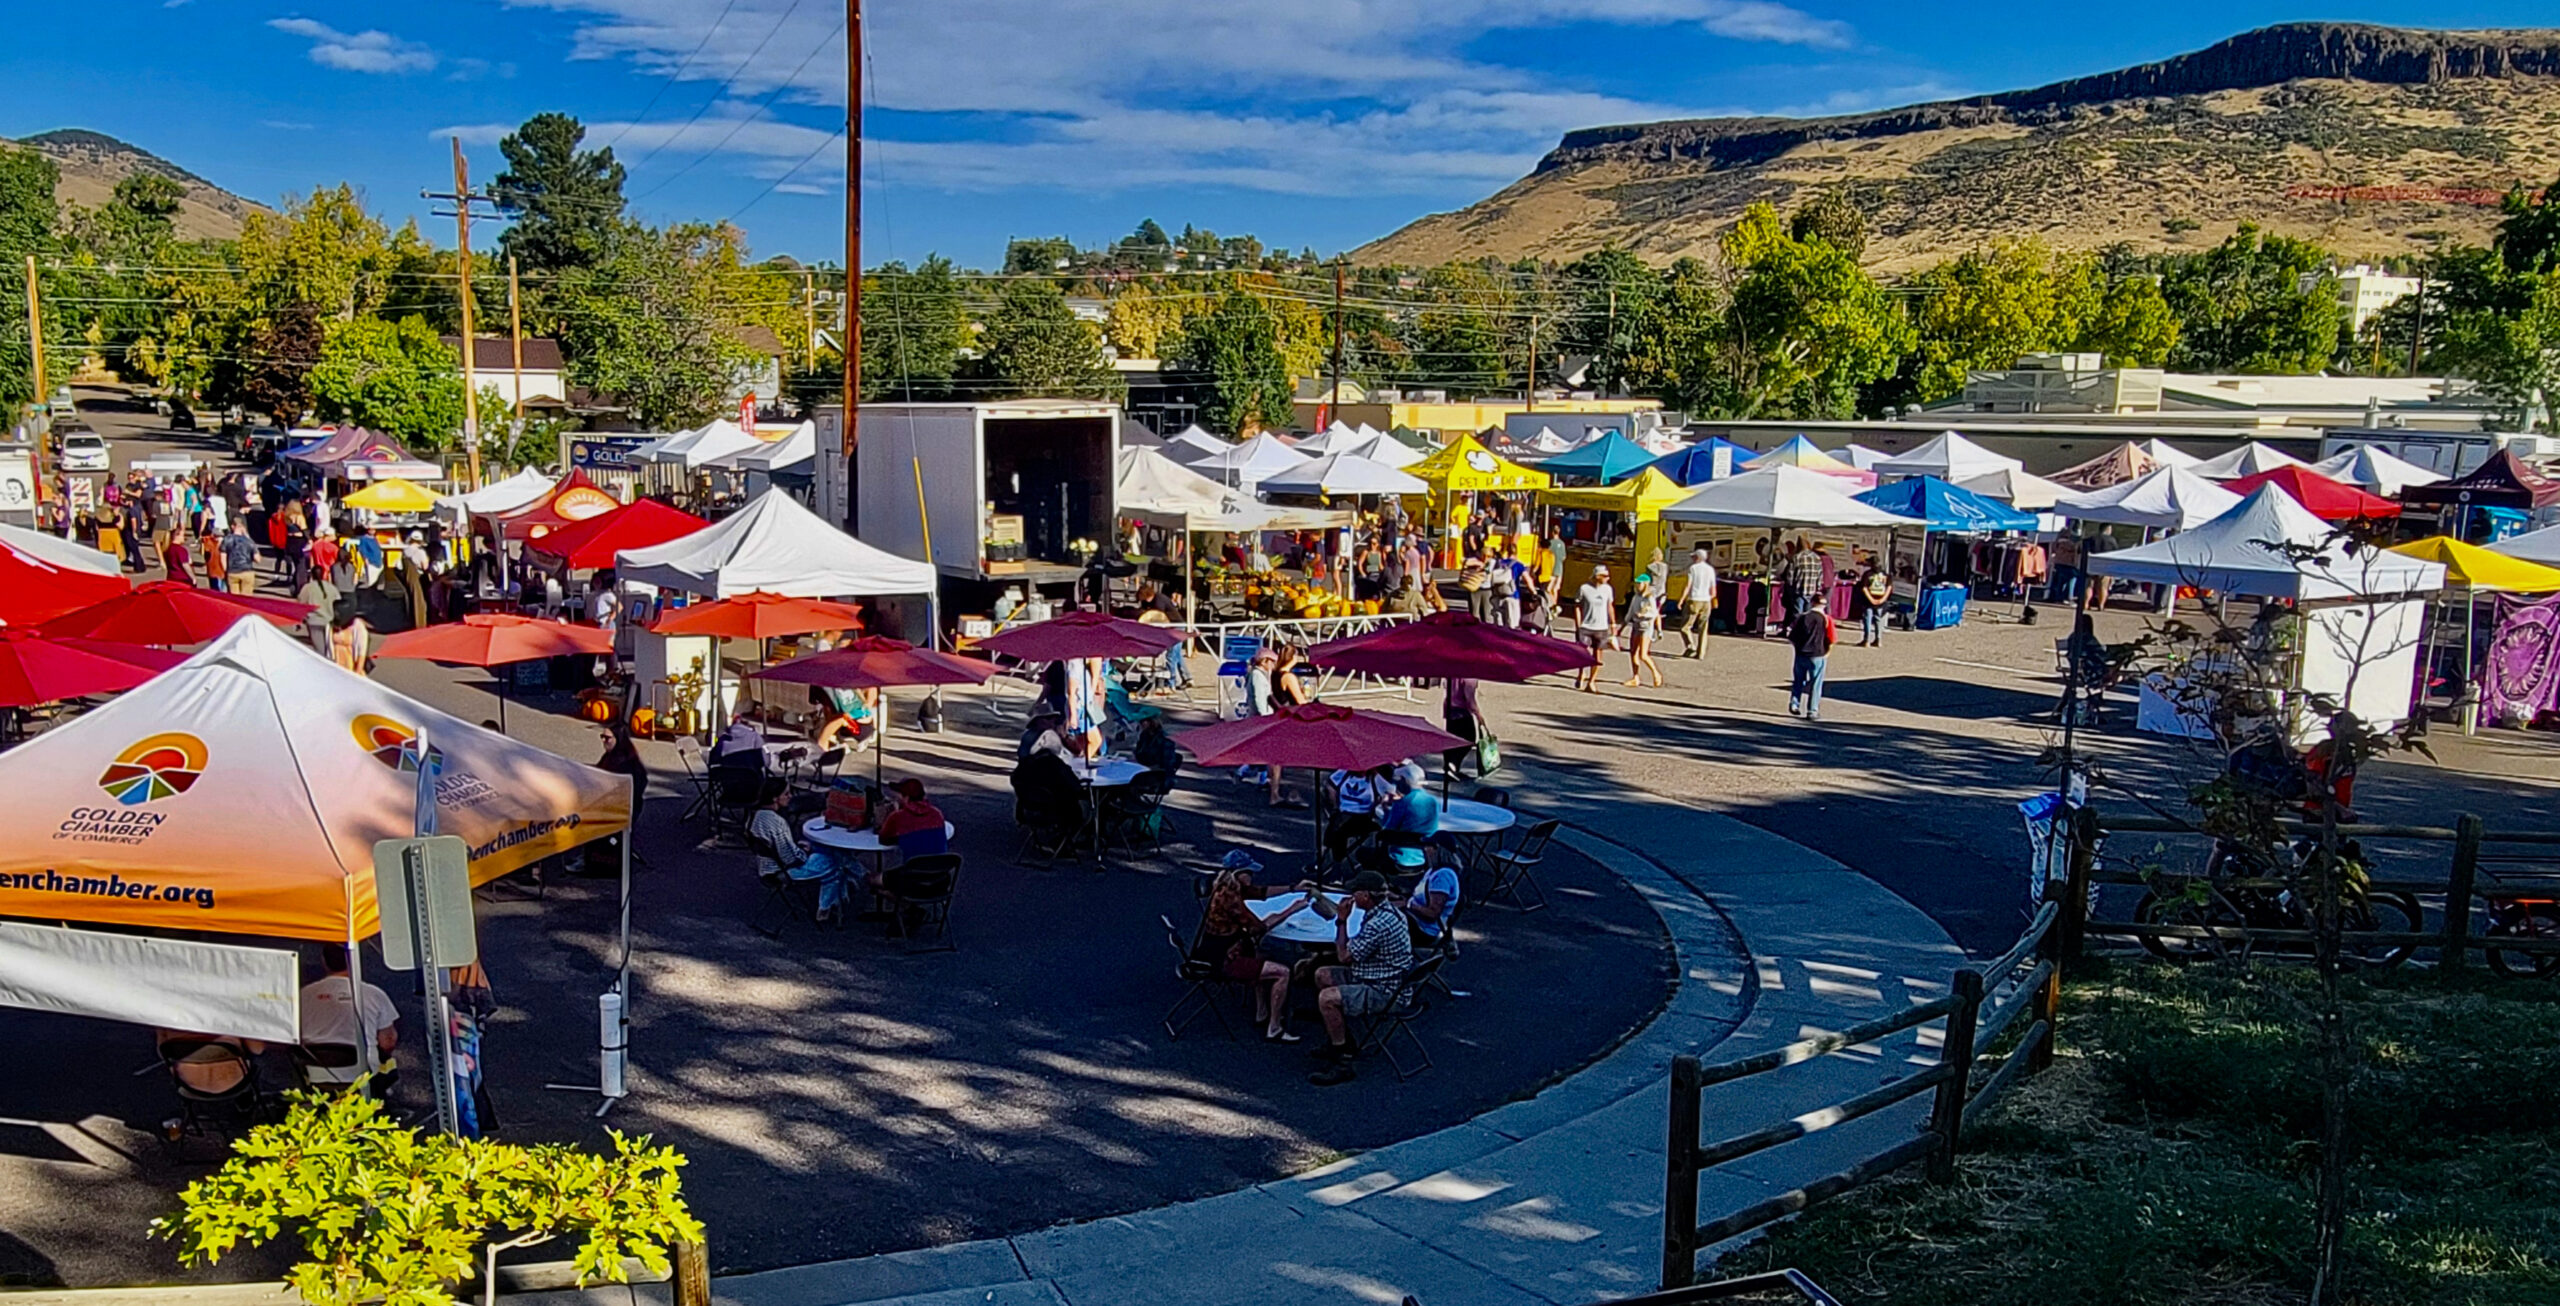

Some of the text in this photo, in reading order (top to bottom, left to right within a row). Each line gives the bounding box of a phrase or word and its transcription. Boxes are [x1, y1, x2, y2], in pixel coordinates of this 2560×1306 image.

[435, 771, 481, 796] OLDEN
[436, 782, 494, 806] CHAMBER
[70, 807, 168, 826] GOLDEN
[52, 832, 145, 845] OF COMMERCE
[59, 820, 154, 837] CHAMBER
[467, 813, 581, 862] enchamber.org
